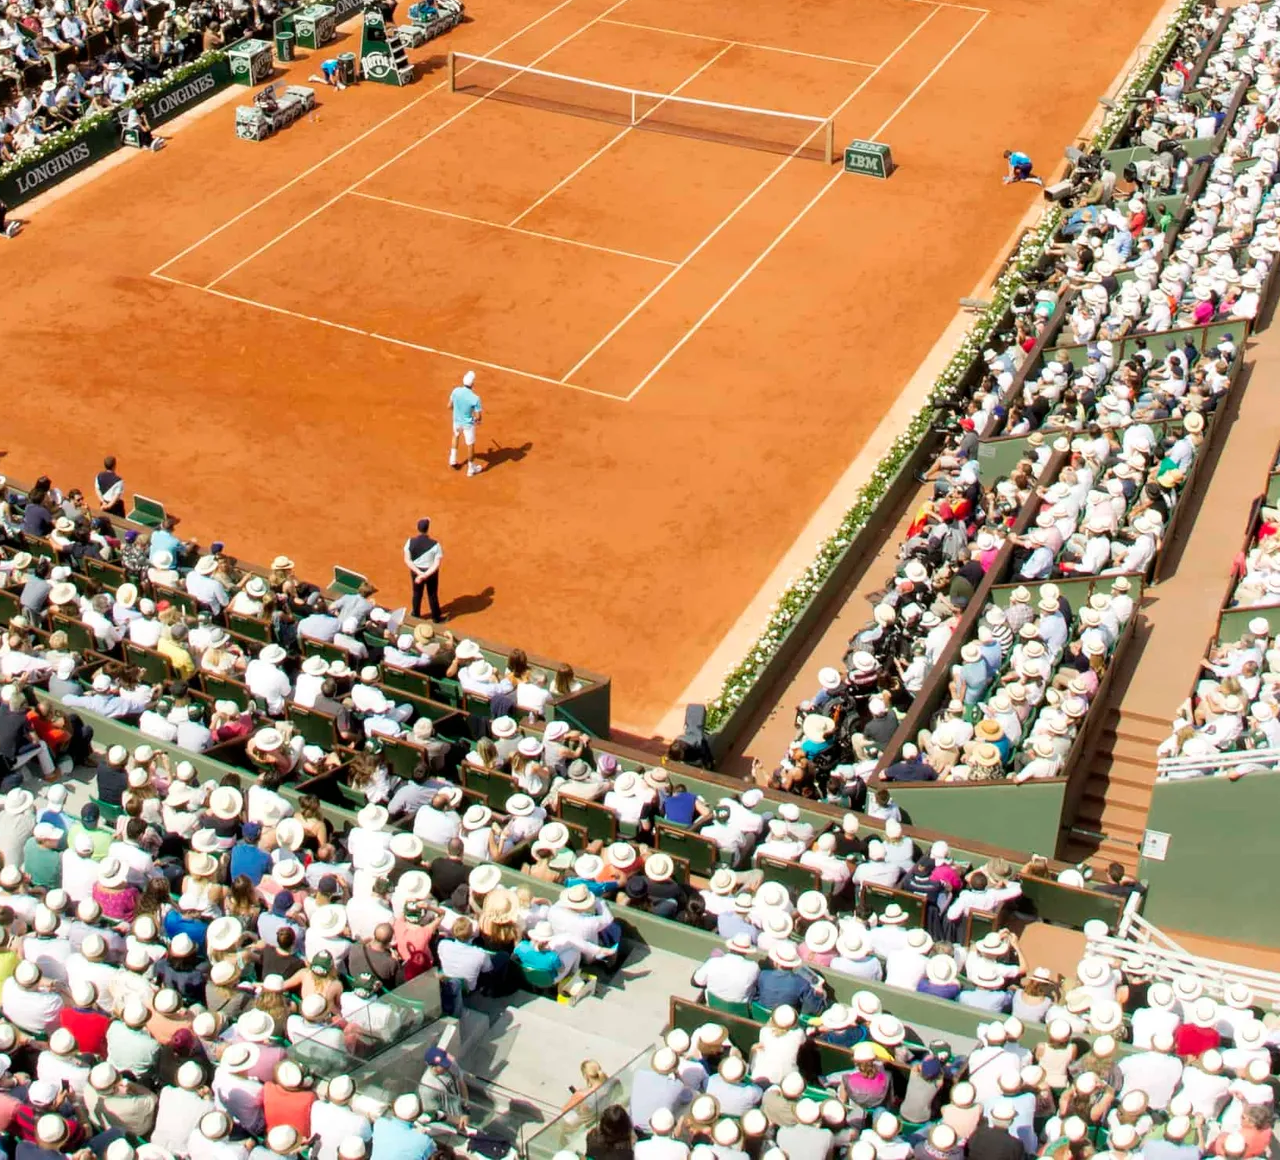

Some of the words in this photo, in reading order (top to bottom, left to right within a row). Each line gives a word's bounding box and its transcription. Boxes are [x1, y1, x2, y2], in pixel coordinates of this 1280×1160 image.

[150, 72, 215, 119] LONGINES
[15, 142, 90, 194] LONGINES
[849, 153, 879, 170] IBM
